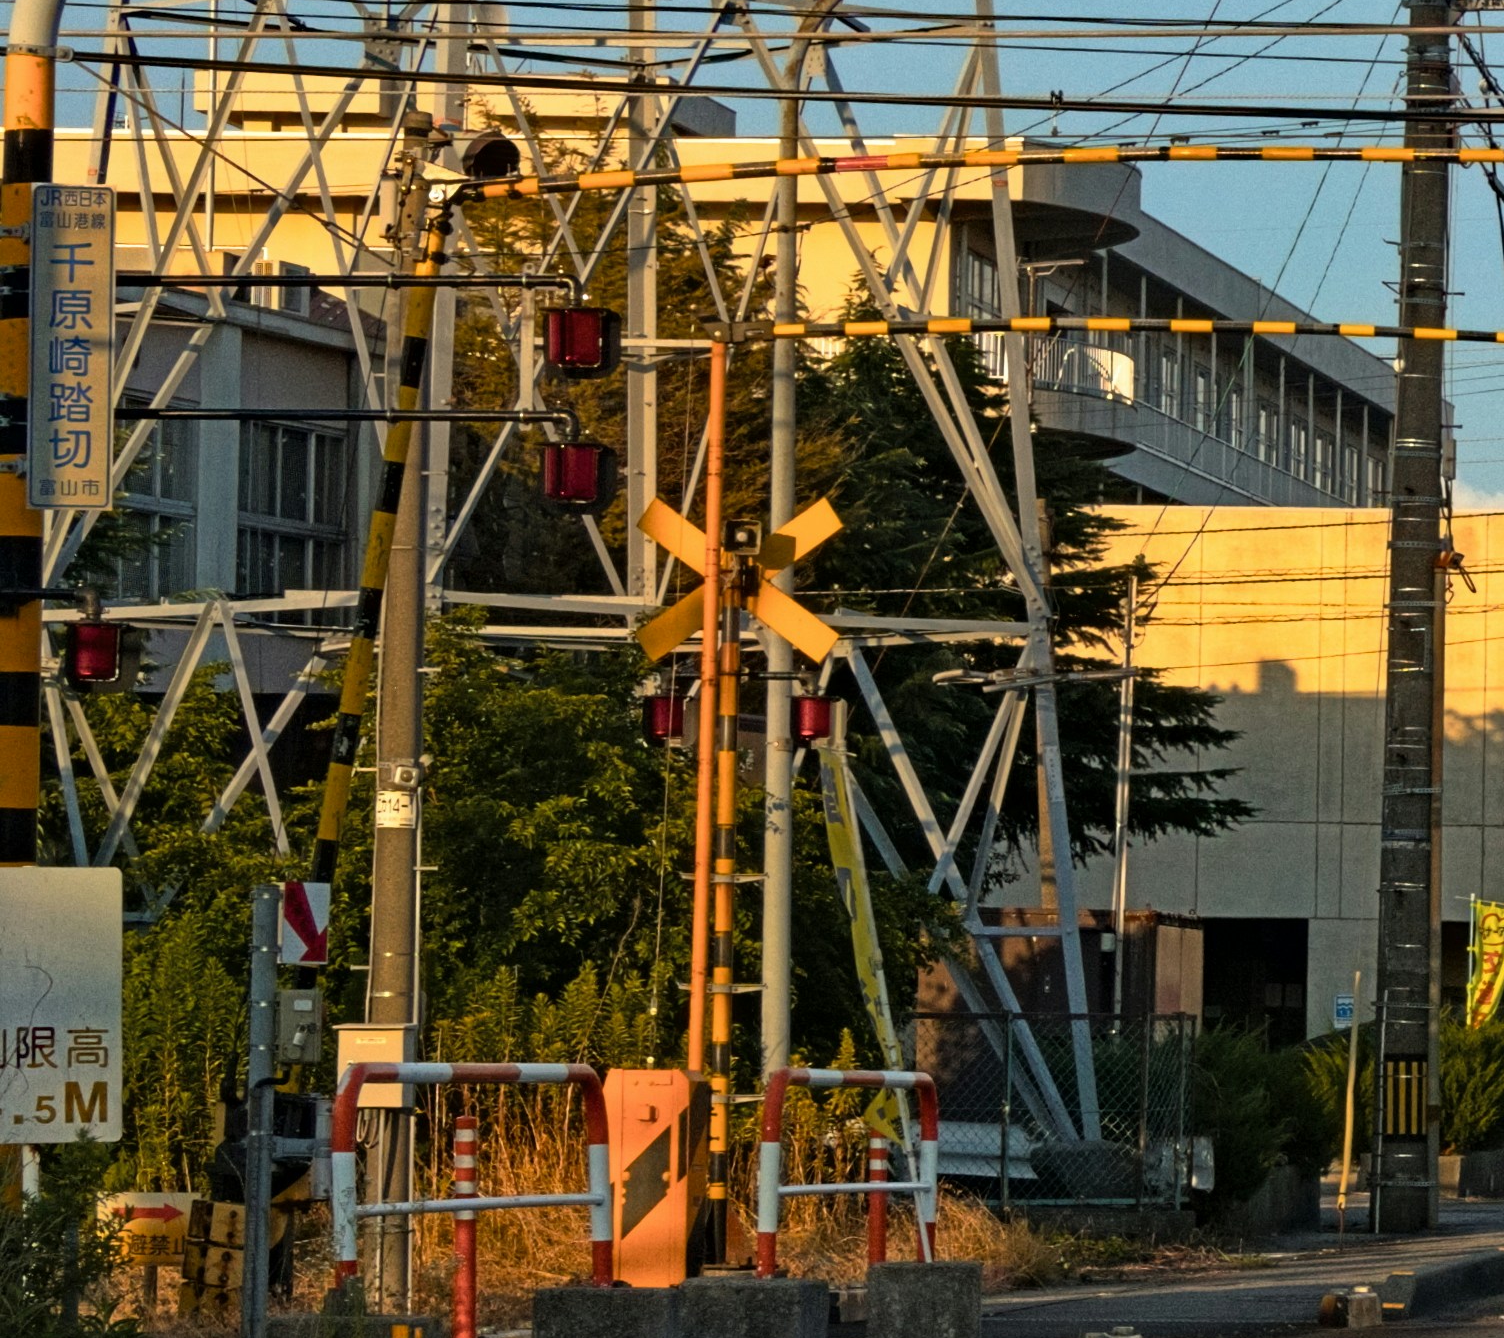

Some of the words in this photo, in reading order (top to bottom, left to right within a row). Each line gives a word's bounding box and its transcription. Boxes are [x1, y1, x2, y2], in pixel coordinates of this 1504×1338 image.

[40, 189, 107, 208] JR西日本
[40, 211, 107, 230] 富山港線
[48, 242, 95, 469] 千原崎踏切
[39, 479, 100, 497] 富山市
[0, 1026, 108, 1069] 限高
[0, 1081, 108, 1124] .5M
